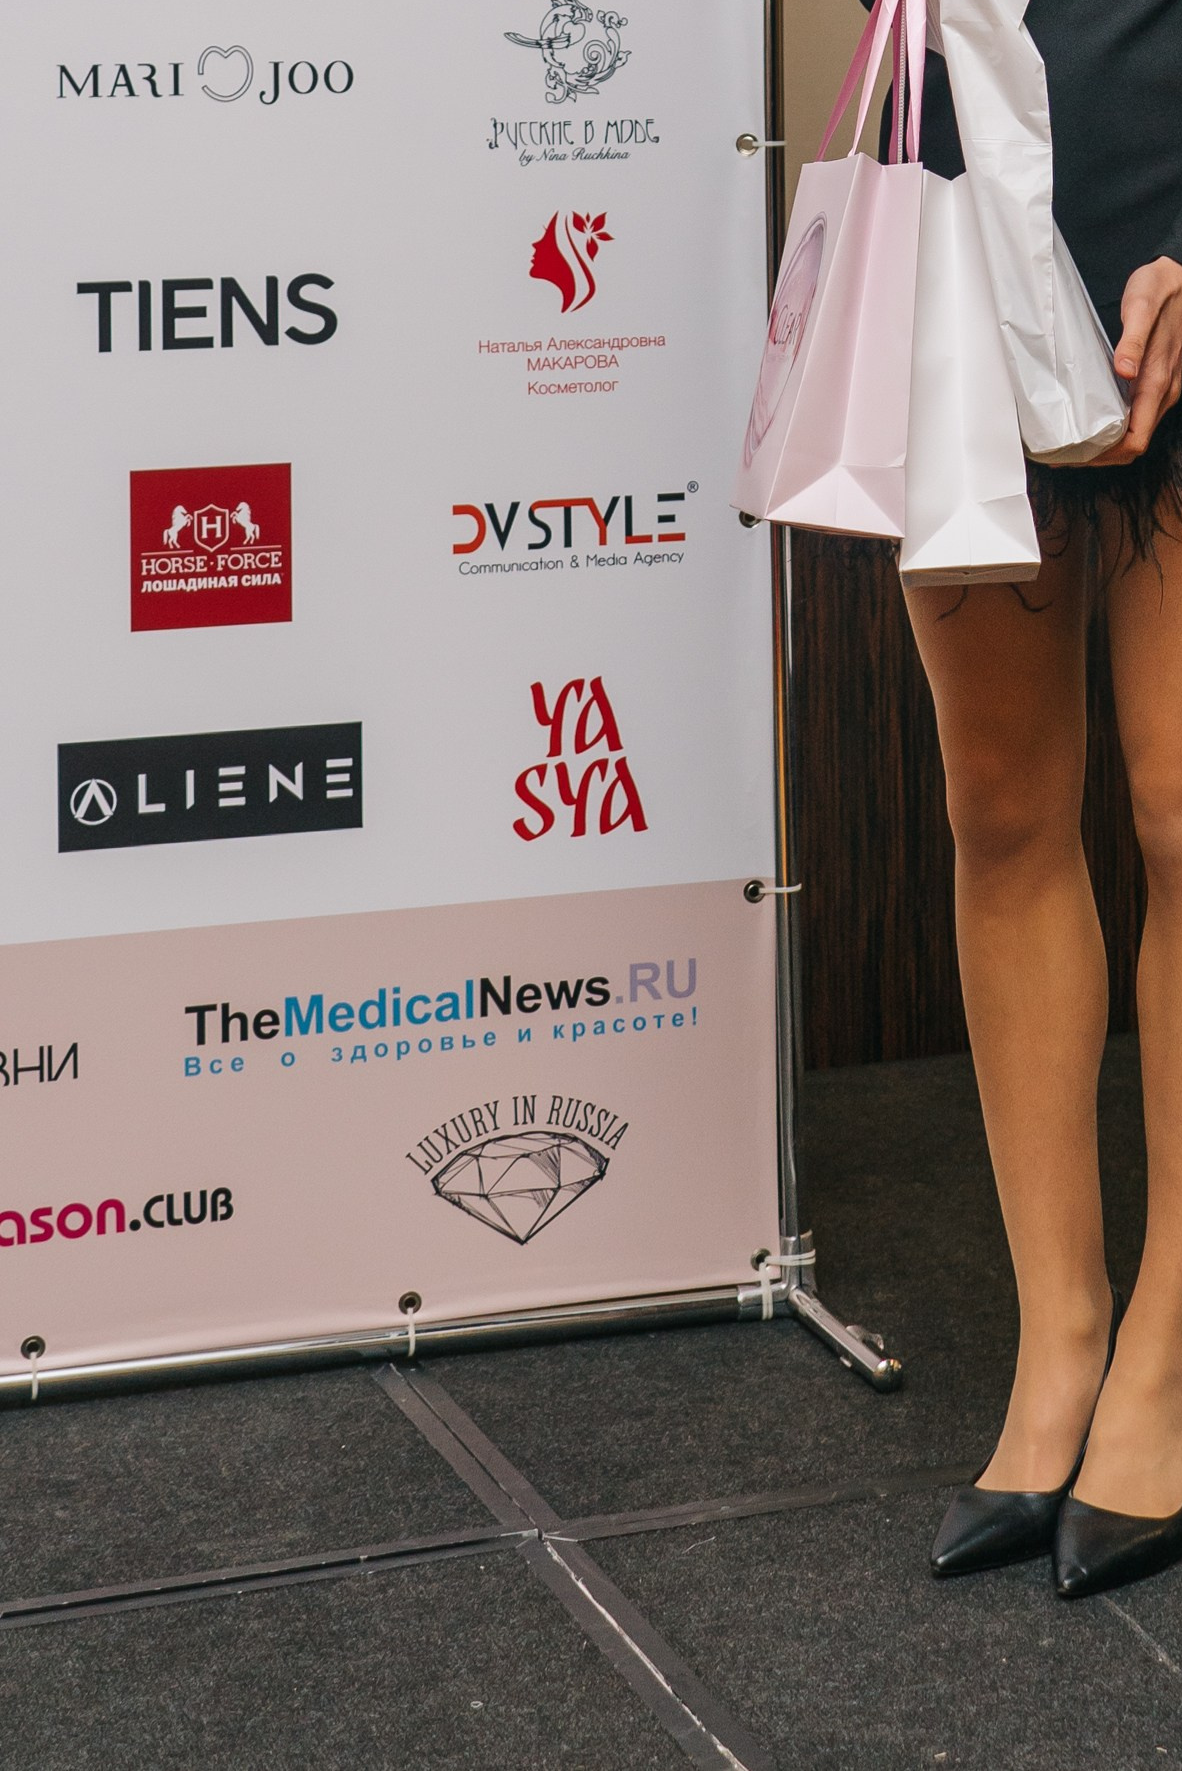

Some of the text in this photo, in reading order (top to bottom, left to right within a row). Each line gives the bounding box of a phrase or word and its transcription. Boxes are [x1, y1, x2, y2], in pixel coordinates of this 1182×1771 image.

[57, 60, 354, 105] MARI JOO
[519, 147, 630, 167] by Nina Ruchkina
[77, 273, 338, 353] TIENS
[478, 334, 666, 354] Наталья Александровна
[527, 354, 620, 372] МАКАРОВА
[527, 379, 619, 396] Косметолог
[141, 573, 282, 593] ЛОШАДИНАЯ СИЛА
[458, 550, 685, 575] Communication & Media Agency
[530, 675, 624, 758] YA
[70, 757, 354, 826] ALIENE
[512, 756, 649, 842] SYA
[185, 958, 697, 1046] TheMedicalNews.RU
[185, 1007, 698, 1077] Все о здоровье и красоте!
[406, 1095, 630, 1176] LUXURY IN RUSSIA
